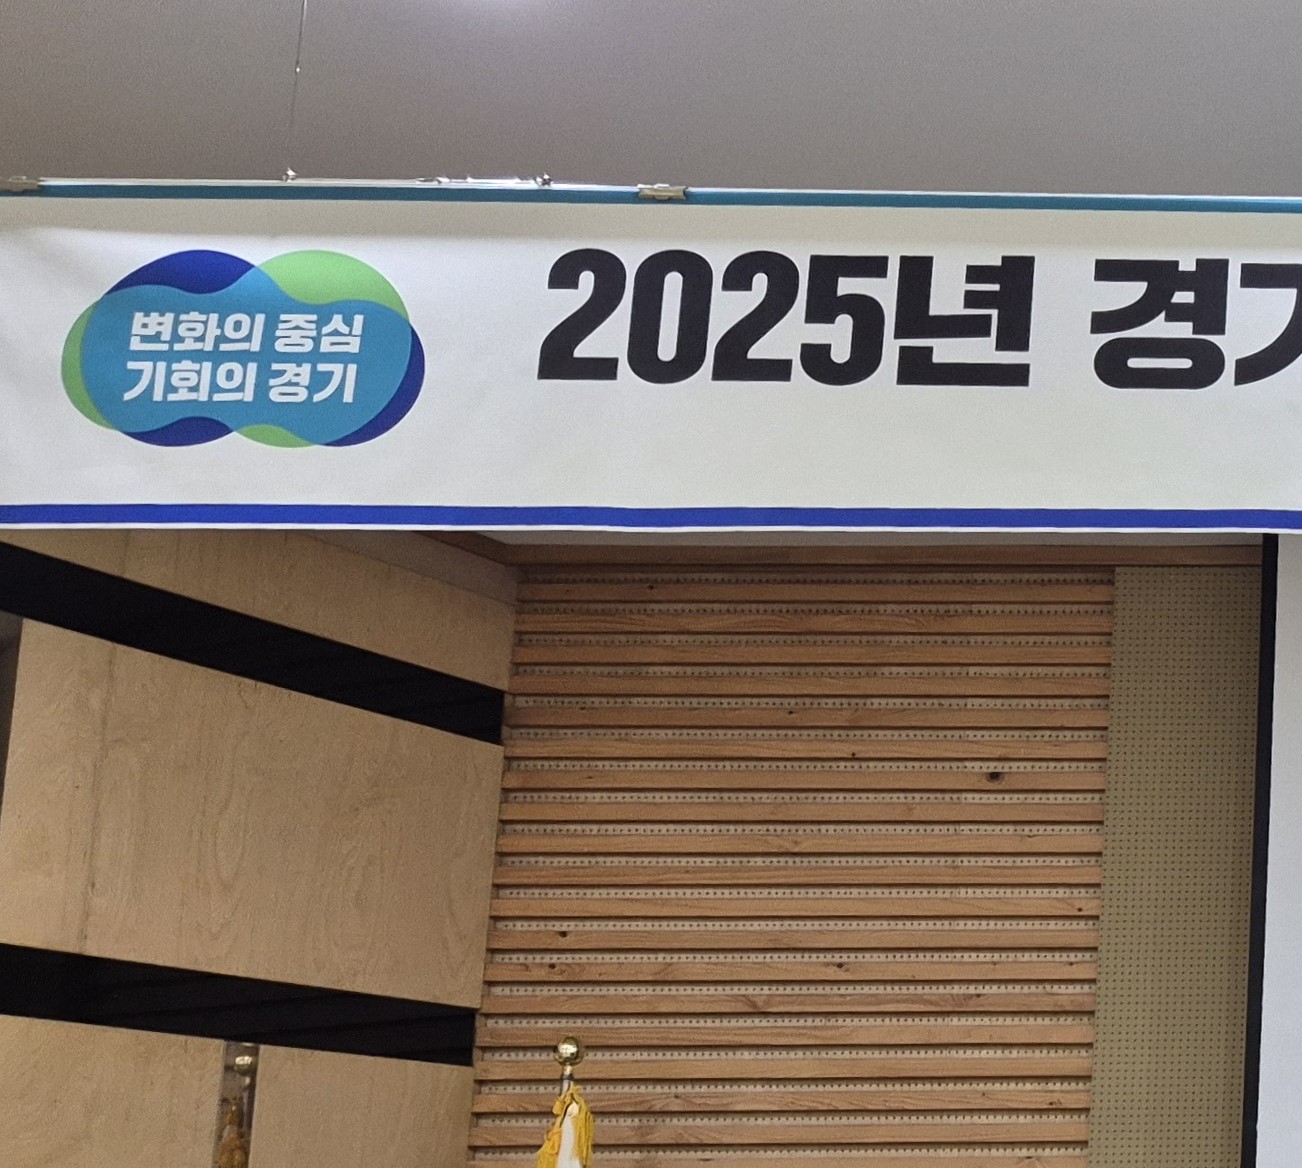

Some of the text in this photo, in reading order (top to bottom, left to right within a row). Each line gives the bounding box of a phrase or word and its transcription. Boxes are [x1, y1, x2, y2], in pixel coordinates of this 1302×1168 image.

[130, 312, 364, 353] 변화의 중심
[538, 248, 1035, 386] 2025년
[123, 360, 357, 403] 기회의 경기
